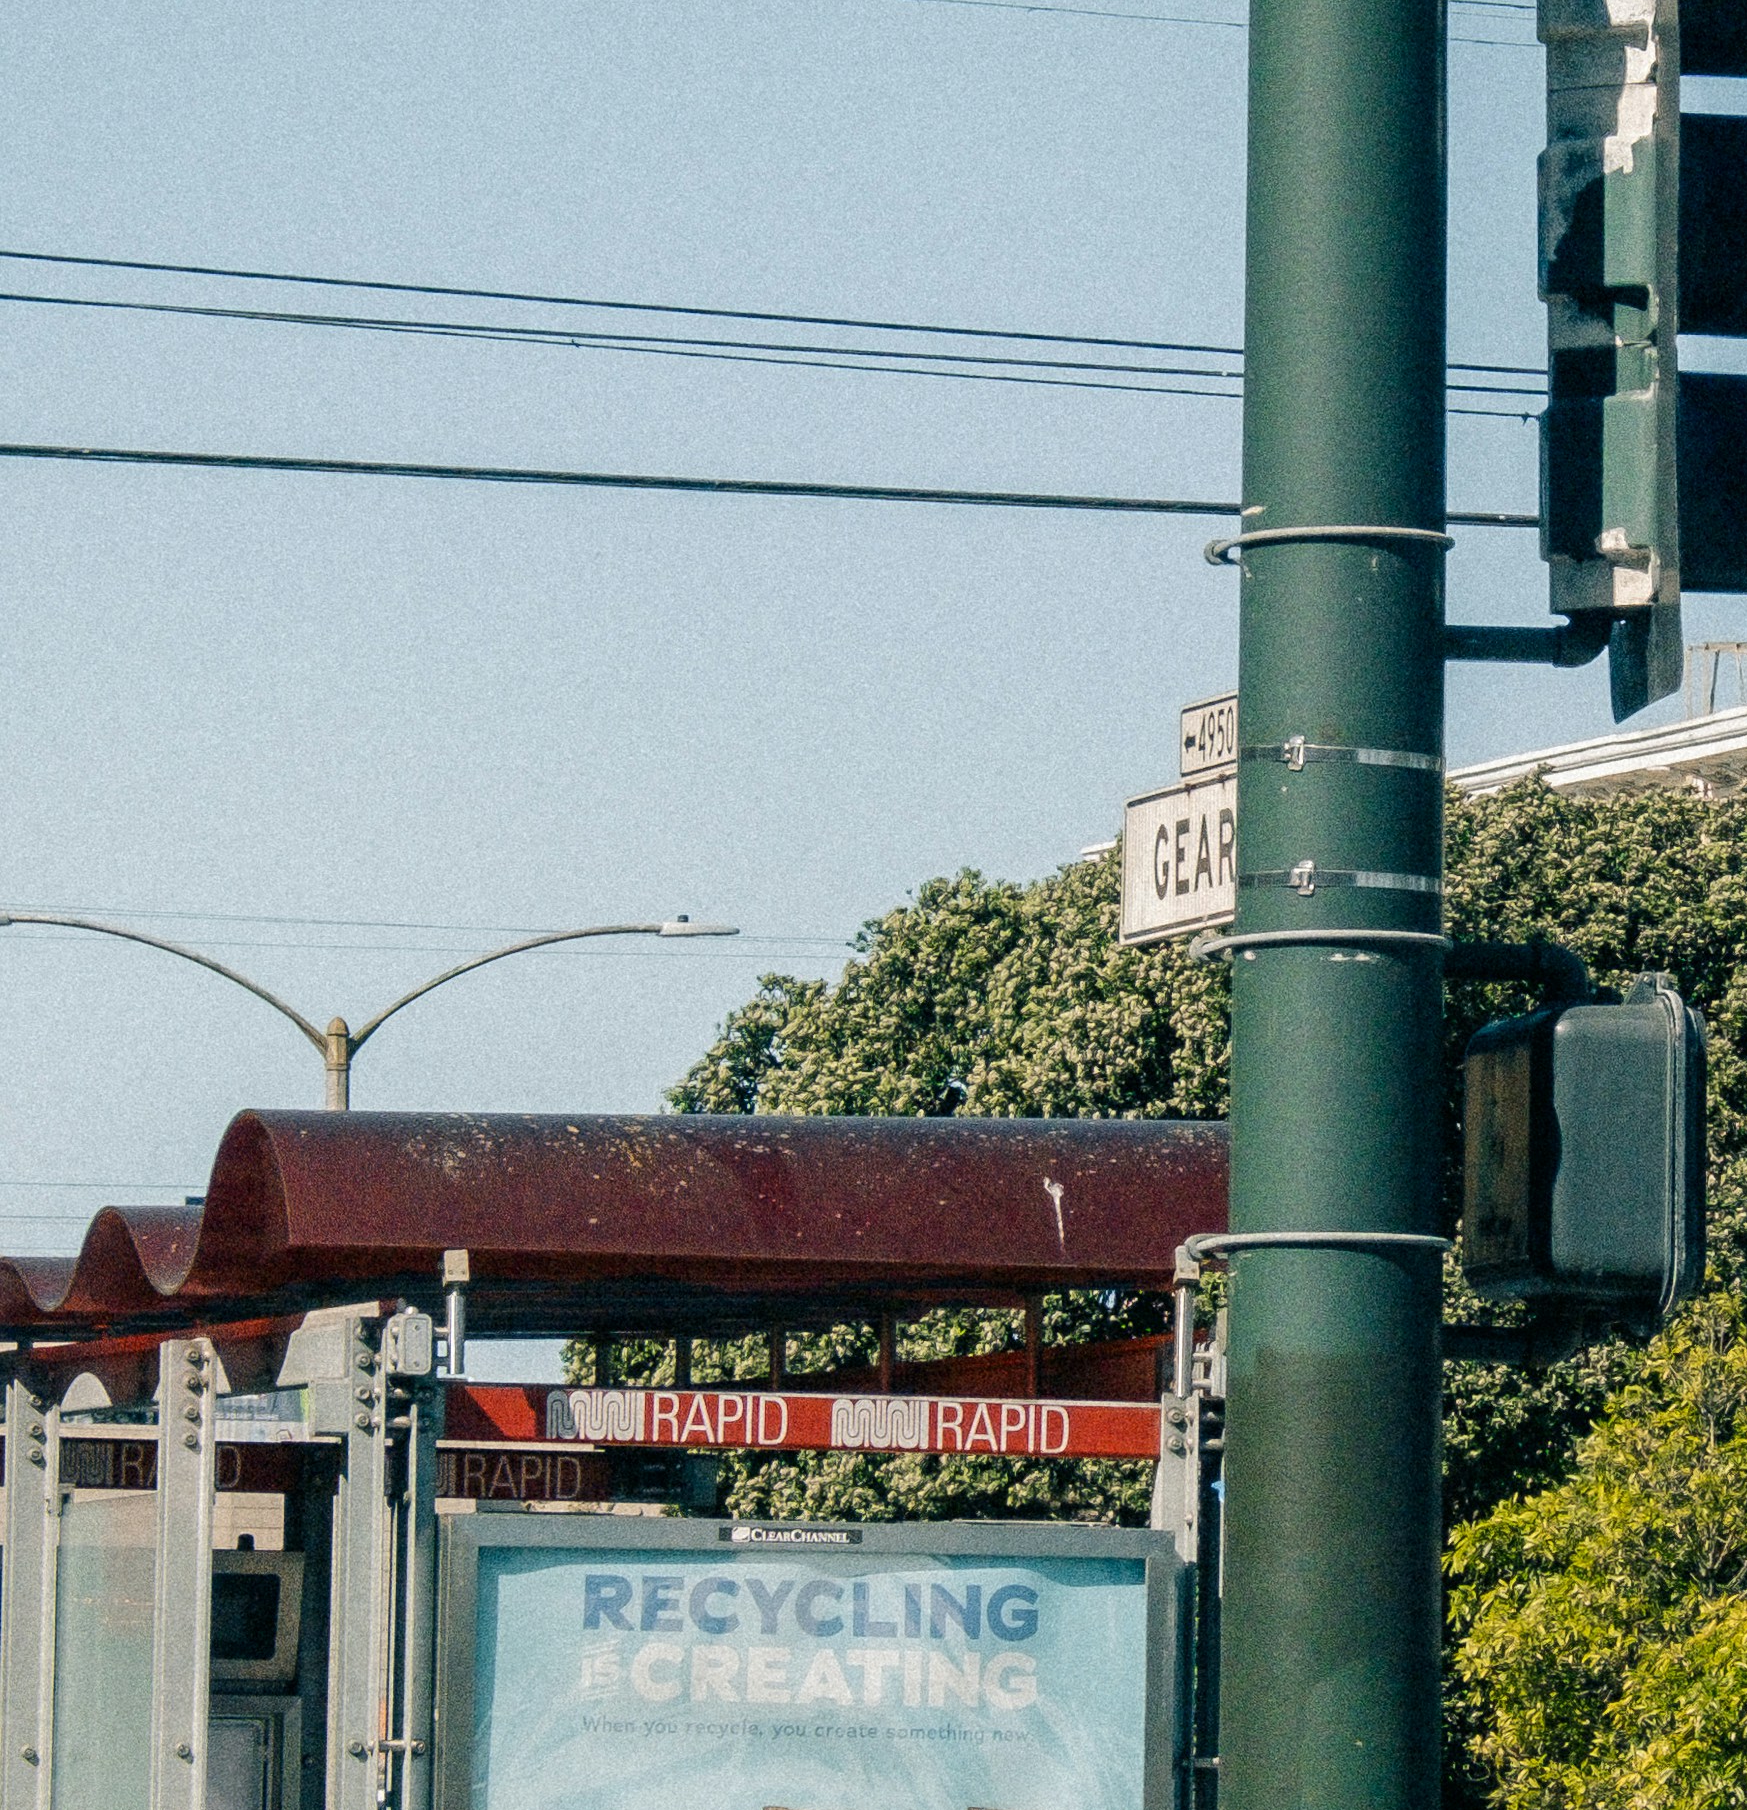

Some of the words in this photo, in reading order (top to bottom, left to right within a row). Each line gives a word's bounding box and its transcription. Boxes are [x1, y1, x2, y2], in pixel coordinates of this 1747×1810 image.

[1199, 706, 1234, 762] 4950
[652, 1393, 788, 1445] RAPID
[937, 1401, 1070, 1454] RAPID
[463, 1453, 581, 1499] RAPID
[583, 1574, 1040, 1642] RECYCLING
[631, 1643, 1038, 1710] CREATING
[582, 1715, 635, 1735] When
[643, 1720, 678, 1737] you
[772, 1723, 808, 1741] you
[814, 1723, 878, 1741] create
[886, 1722, 985, 1743] something
